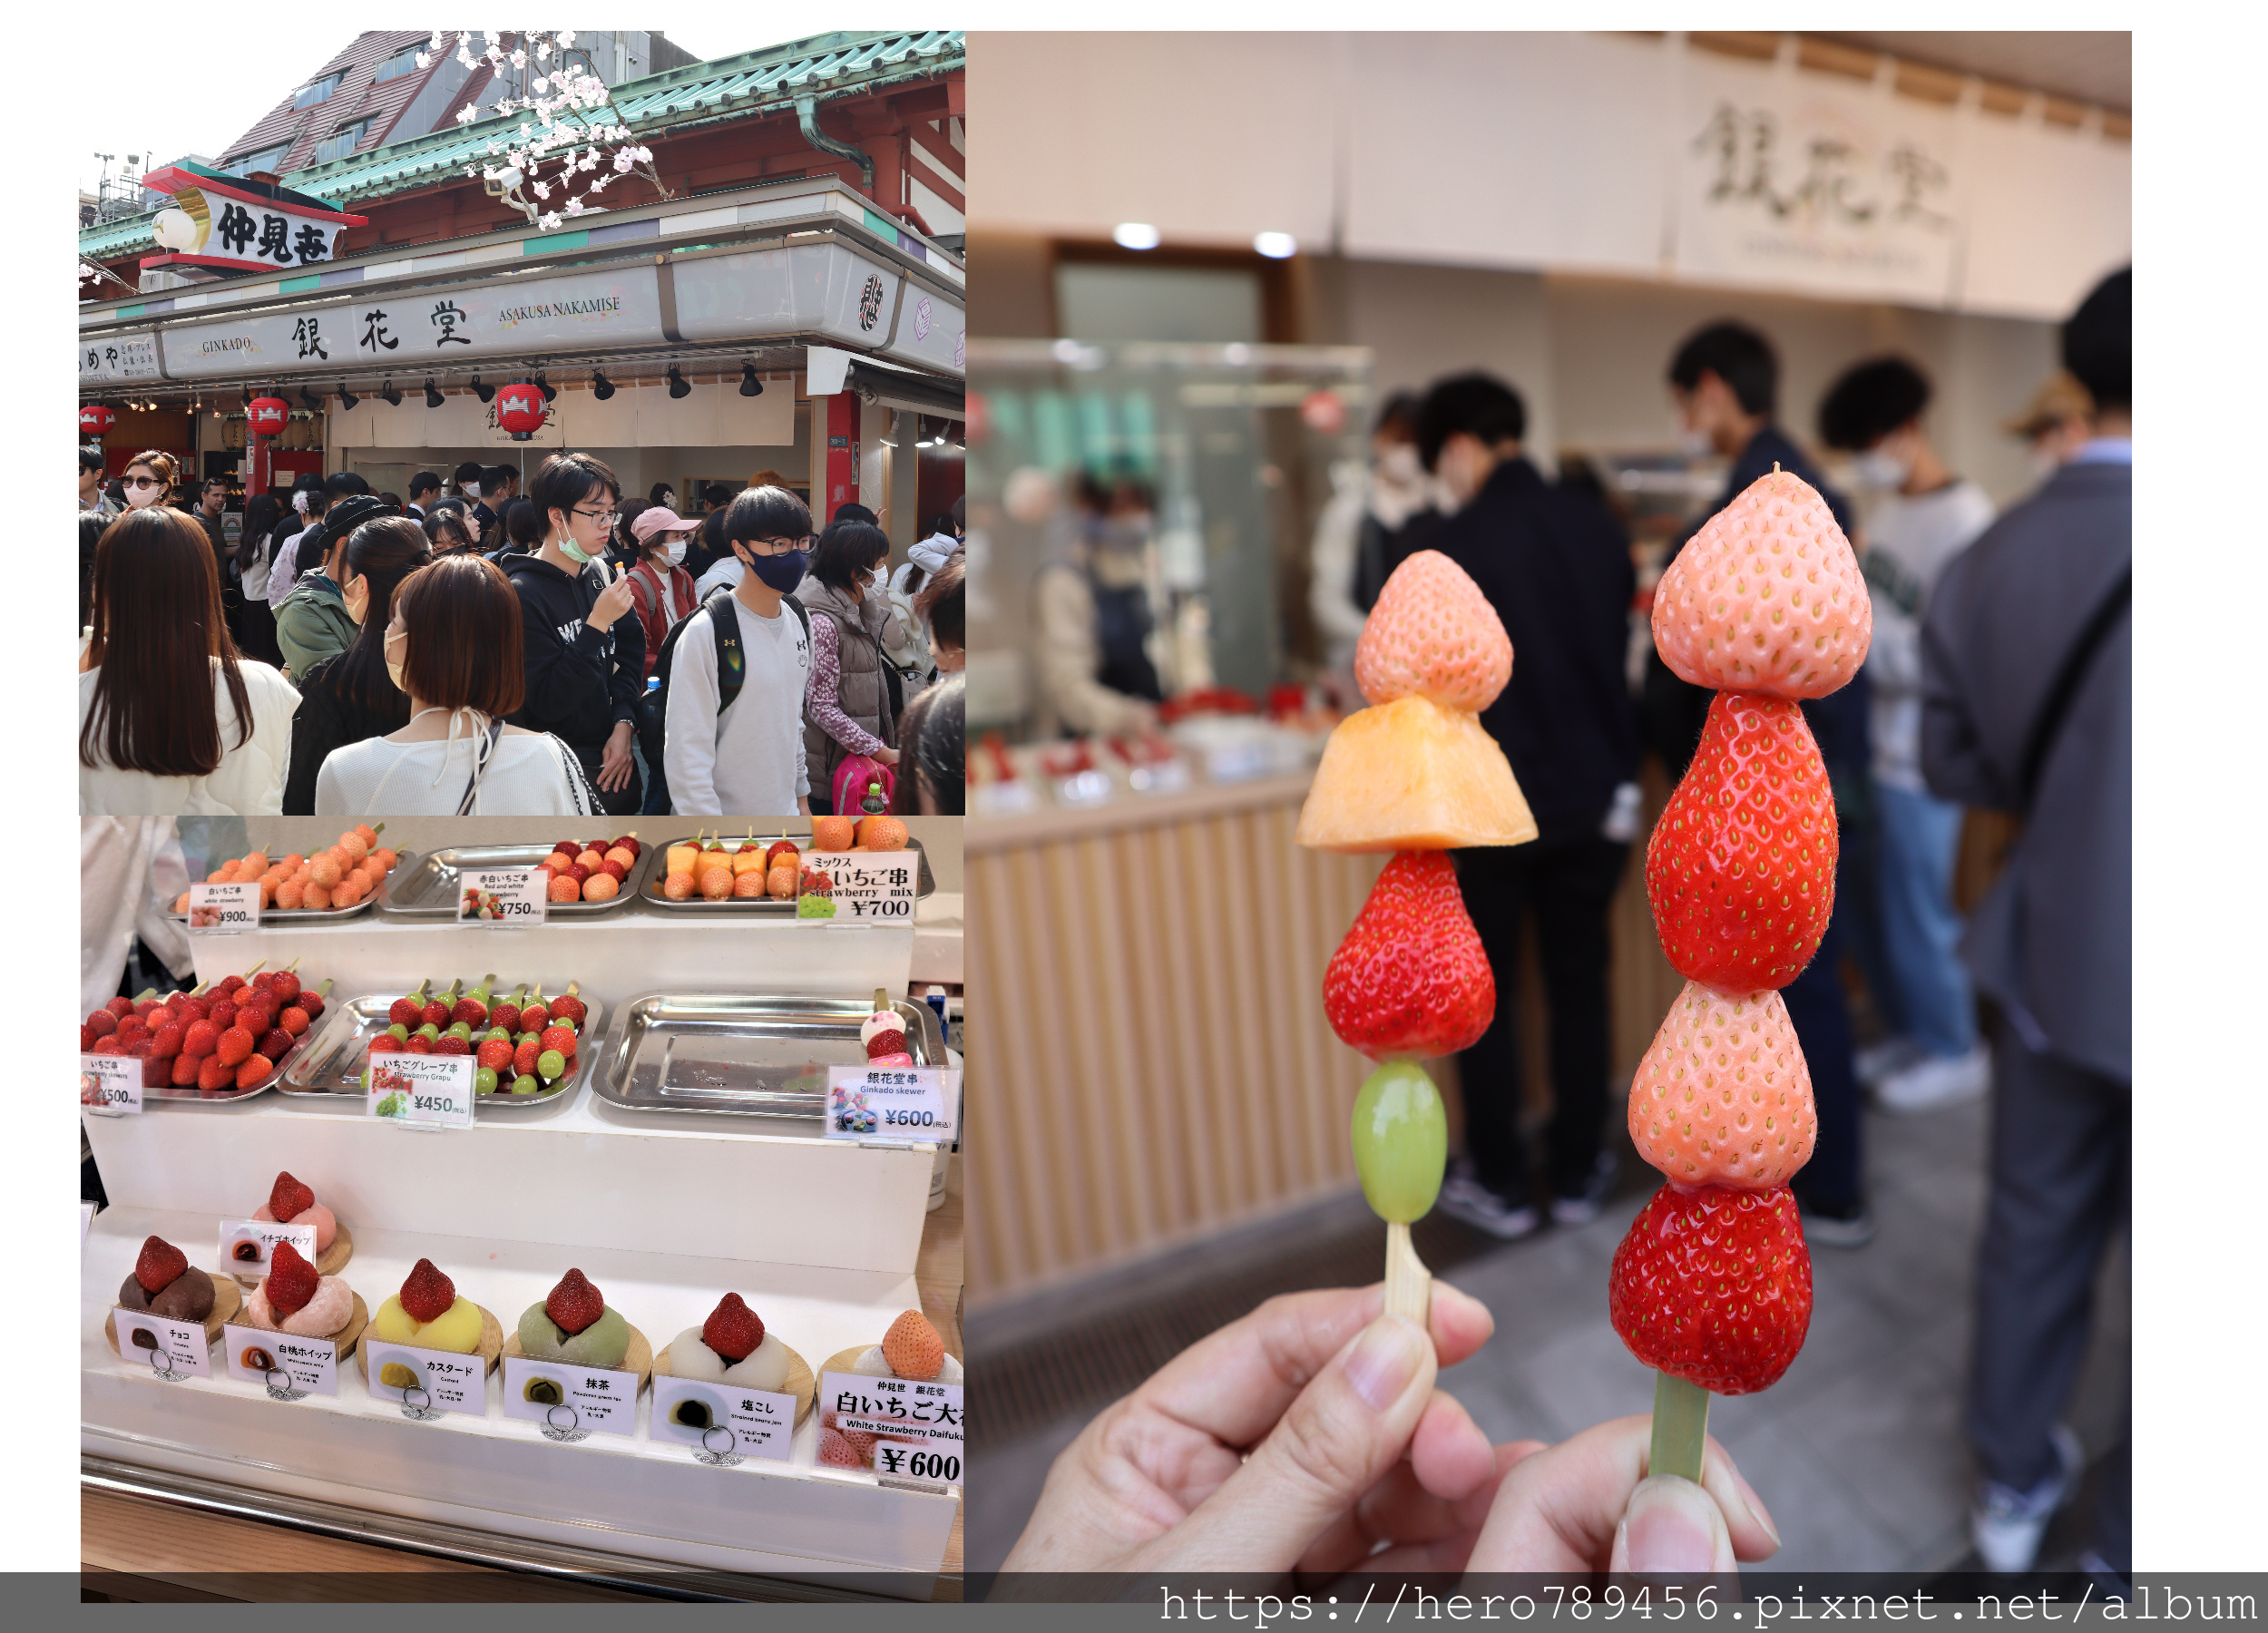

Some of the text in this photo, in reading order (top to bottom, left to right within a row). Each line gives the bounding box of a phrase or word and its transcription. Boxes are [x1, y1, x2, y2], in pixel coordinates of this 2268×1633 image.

[499, 297, 621, 322] ASAKUSA NAKAMISE
[291, 299, 471, 360] 銀花堂
[202, 337, 251, 353] GINKADO
[814, 857, 852, 868] ミックス
[480, 874, 529, 884] 赤白いちご串
[834, 867, 908, 887] いちご串
[809, 887, 914, 898] strawberry mix
[498, 903, 531, 914] ¥750
[851, 900, 910, 916] ¥700
[220, 911, 246, 922] ¥900
[384, 1059, 458, 1074] いちごグレープ串
[394, 1071, 452, 1082] strawberry Grapu
[866, 1071, 918, 1085] 銀花堂串
[101, 1089, 128, 1103] ¥500
[860, 1085, 926, 1095] Ginkado skewer
[414, 1095, 453, 1112] ¥450
[885, 1110, 934, 1127] ¥600
[169, 1329, 190, 1340] チョコ
[279, 1344, 333, 1361] 白桃ホイップ
[426, 1361, 474, 1376] カスタード
[585, 1377, 611, 1391] 抹茶
[877, 1381, 946, 1397] 仲見世 銀花堂
[741, 1399, 774, 1413] 塩こし
[846, 1419, 875, 1431] White
[875, 1423, 927, 1438] Strawberry
[881, 1448, 961, 1481] ¥600
